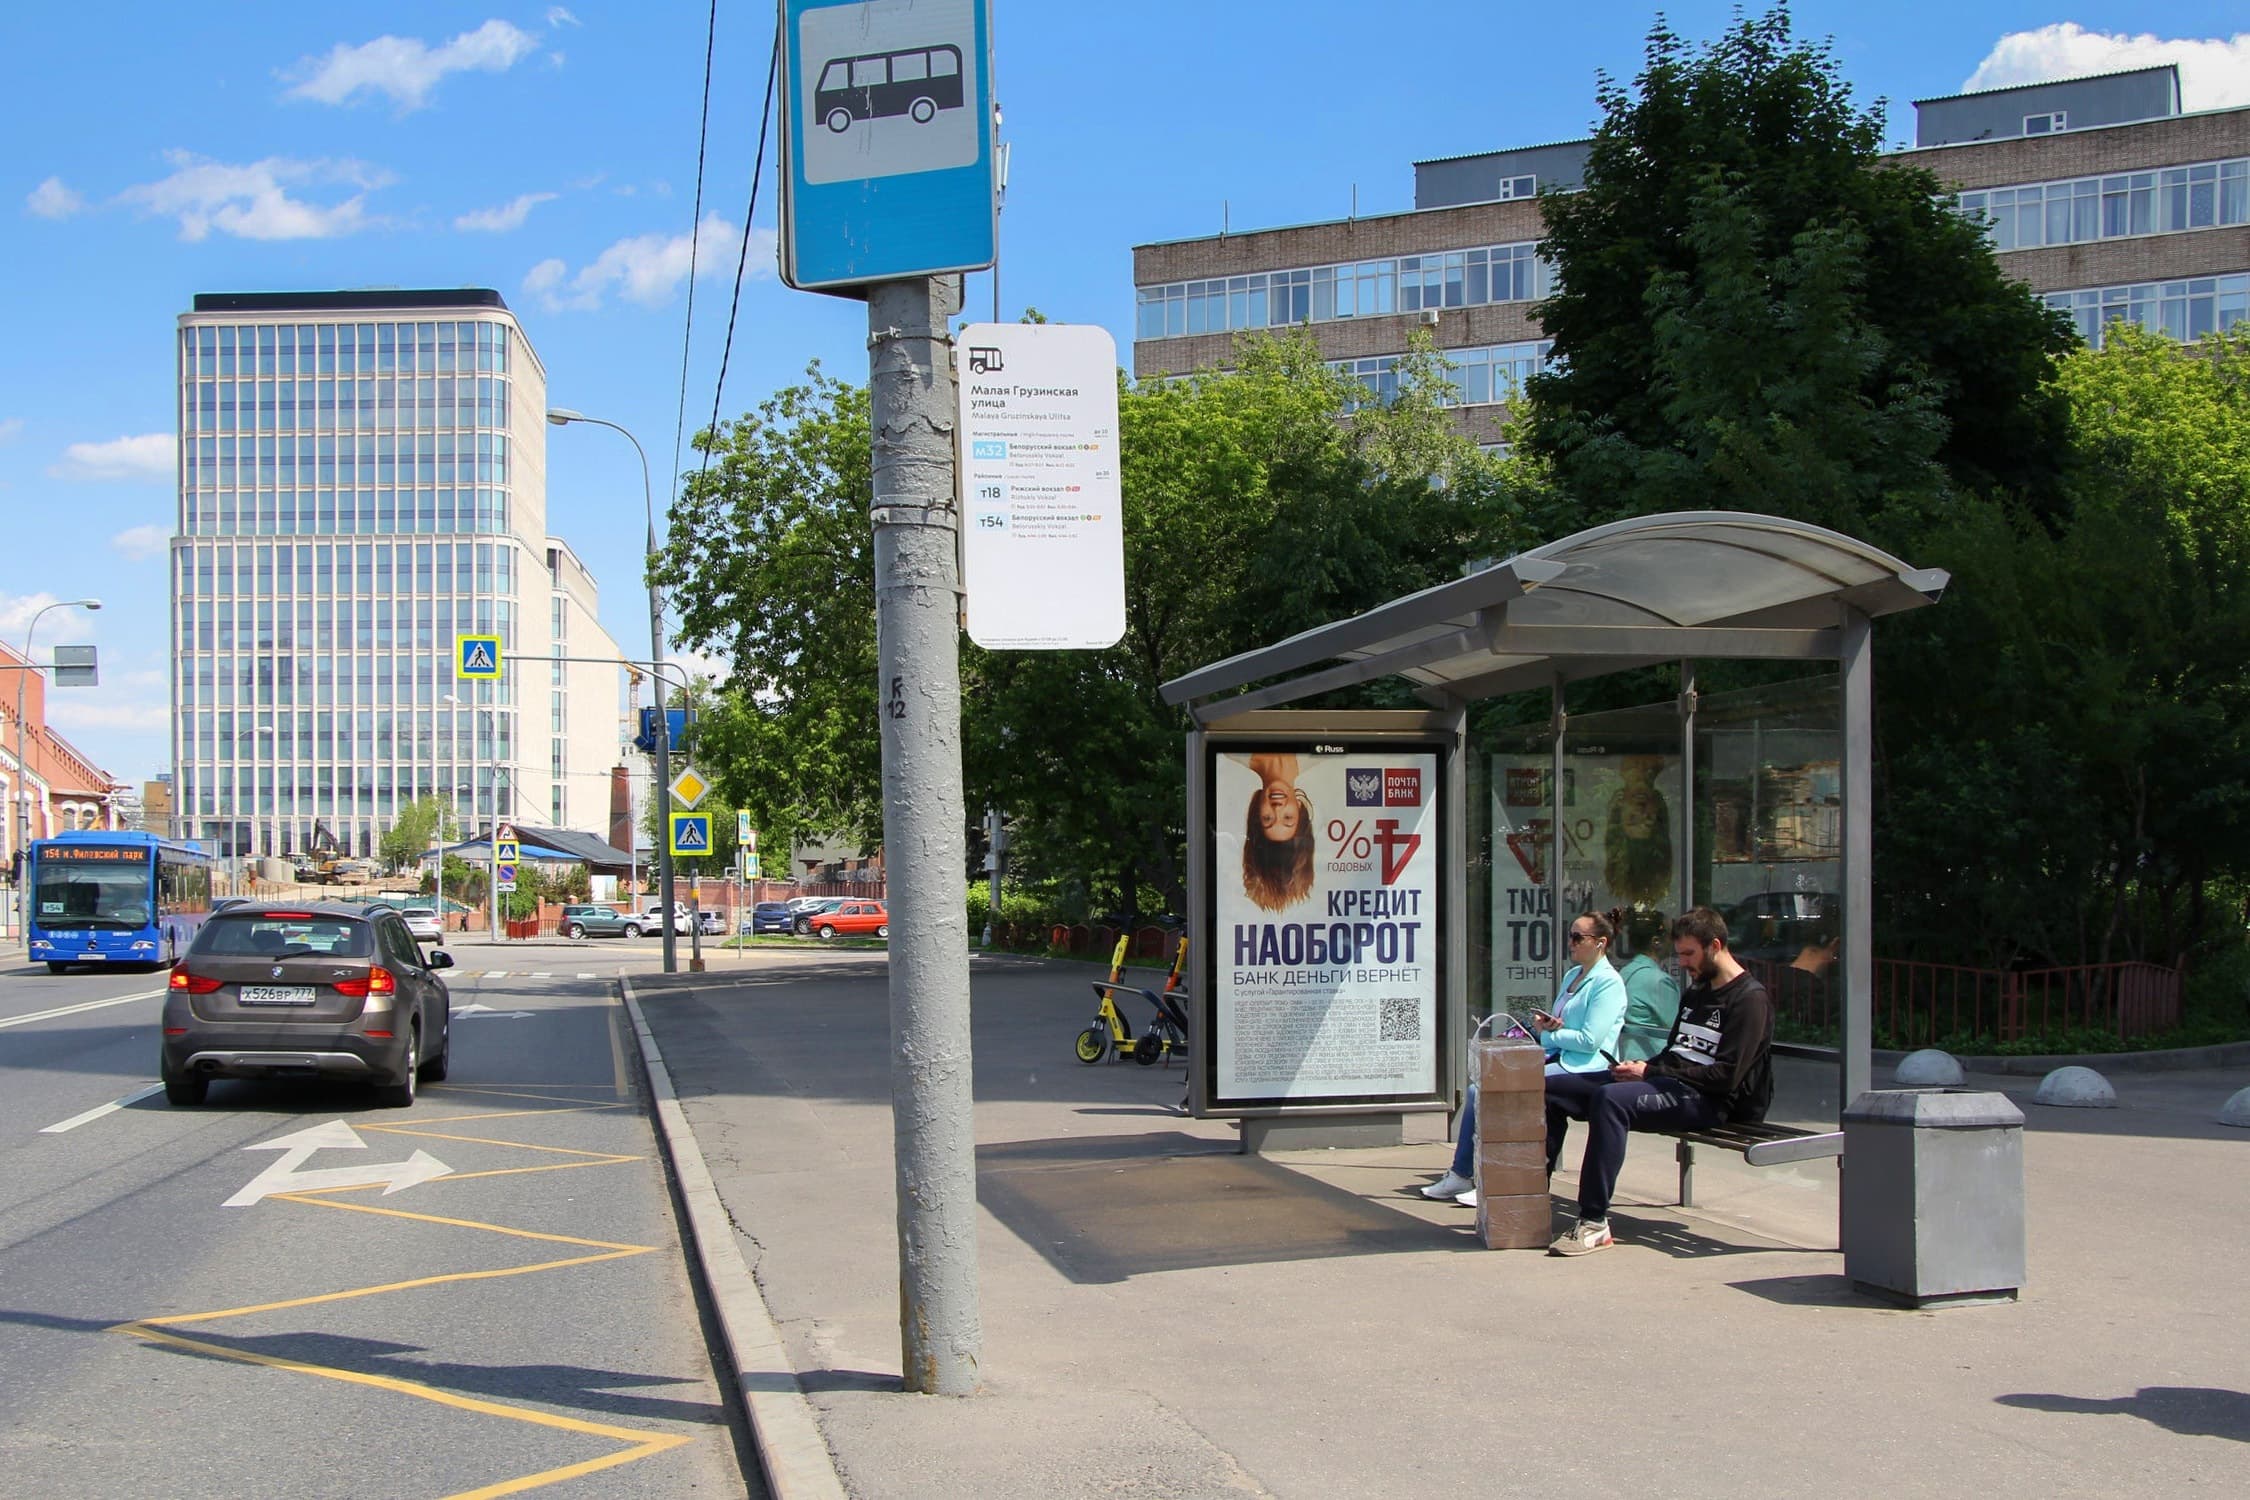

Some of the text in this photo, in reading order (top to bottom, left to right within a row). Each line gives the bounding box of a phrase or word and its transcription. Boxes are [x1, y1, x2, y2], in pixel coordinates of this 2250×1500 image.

[971, 385, 1079, 398] Малая Грузинская
[971, 400, 1006, 409] улица
[971, 412, 1000, 421] Malaya
[980, 487, 1001, 499] т18
[980, 516, 1004, 528] т54
[888, 700, 906, 719] 12
[1324, 745, 1344, 753] Russ
[1388, 777, 1418, 787] ПОЧТА
[1388, 788, 1414, 799] БАНК
[44, 848, 60, 859] т54
[122, 851, 143, 861] парк
[1327, 862, 1373, 872] ГОДОВЫХ
[1327, 890, 1422, 919] КРЕДИТ
[1234, 922, 1421, 966] НАОБОРОТ
[1233, 966, 1421, 986] БАНК ДЕНЬГИ ВЕРНЁТ
[294, 987, 312, 997] 777
